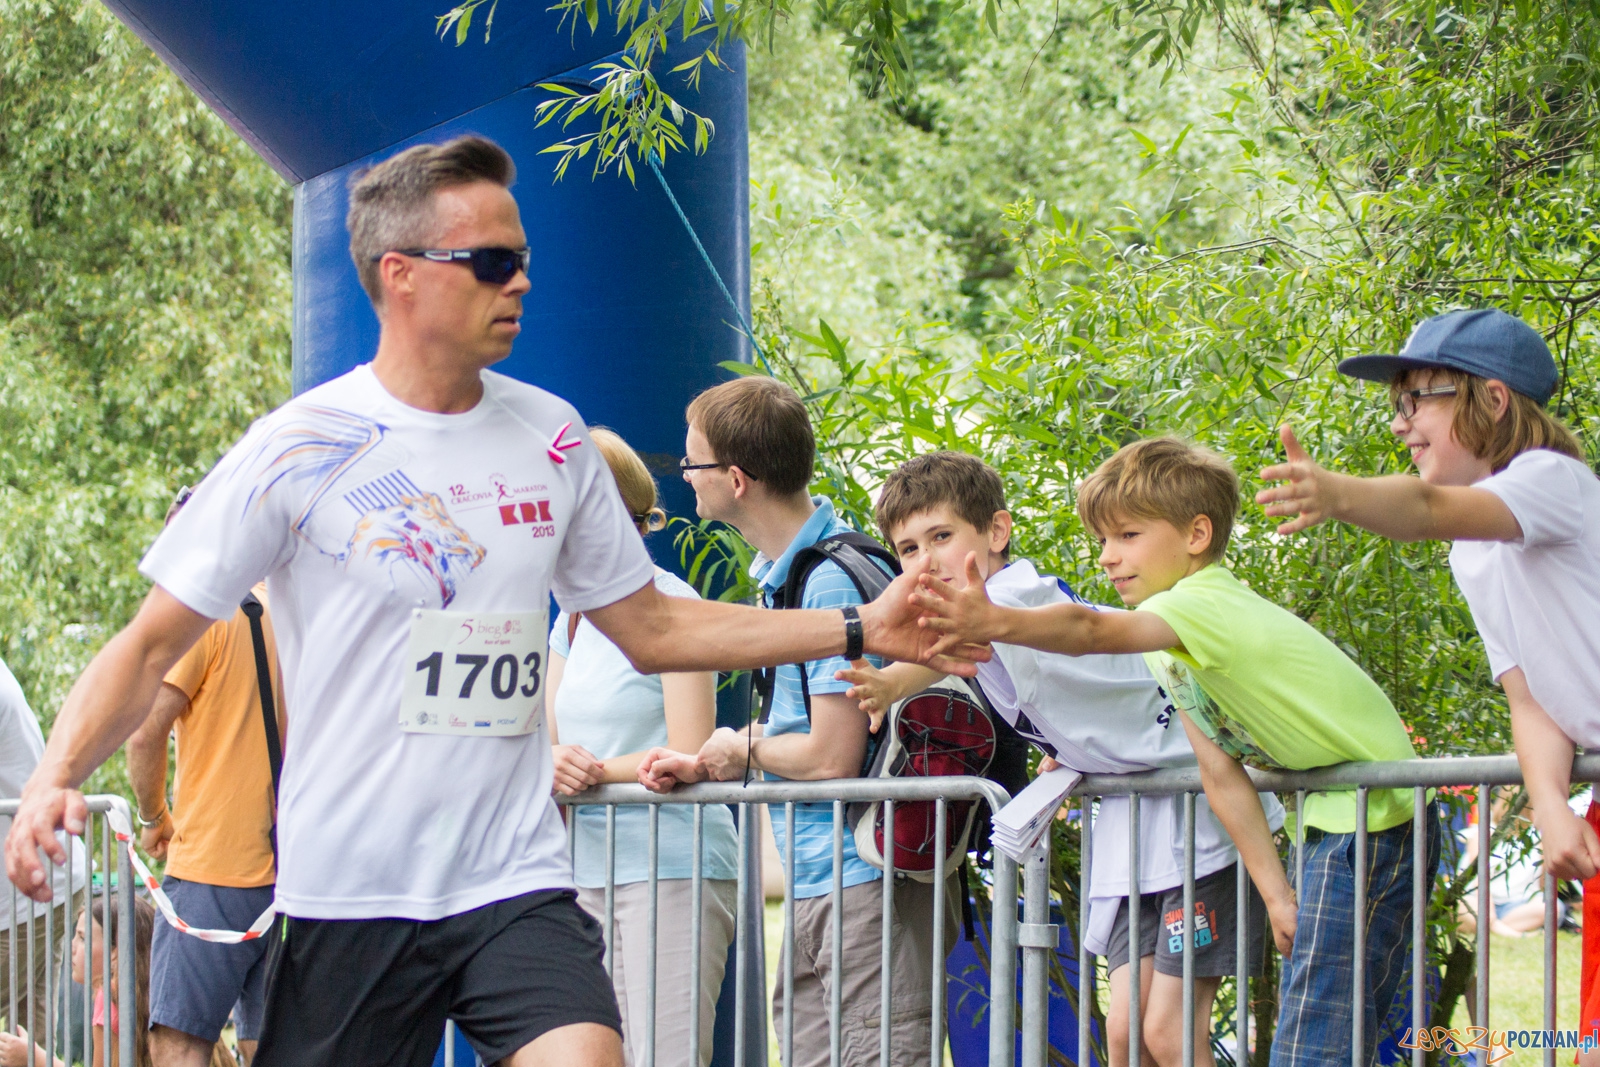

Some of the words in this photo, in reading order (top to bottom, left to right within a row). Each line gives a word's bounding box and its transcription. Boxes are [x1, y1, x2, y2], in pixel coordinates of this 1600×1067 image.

[449, 484, 470, 496] 12.
[451, 491, 493, 505] CRACOVIA
[513, 484, 548, 495] MARATON
[498, 500, 553, 526] KRK
[532, 525, 555, 538] 2013
[458, 618, 474, 645] 5
[415, 651, 541, 700] 1703
[1164, 901, 1206, 926] SUMR
[1166, 915, 1209, 936] TIE
